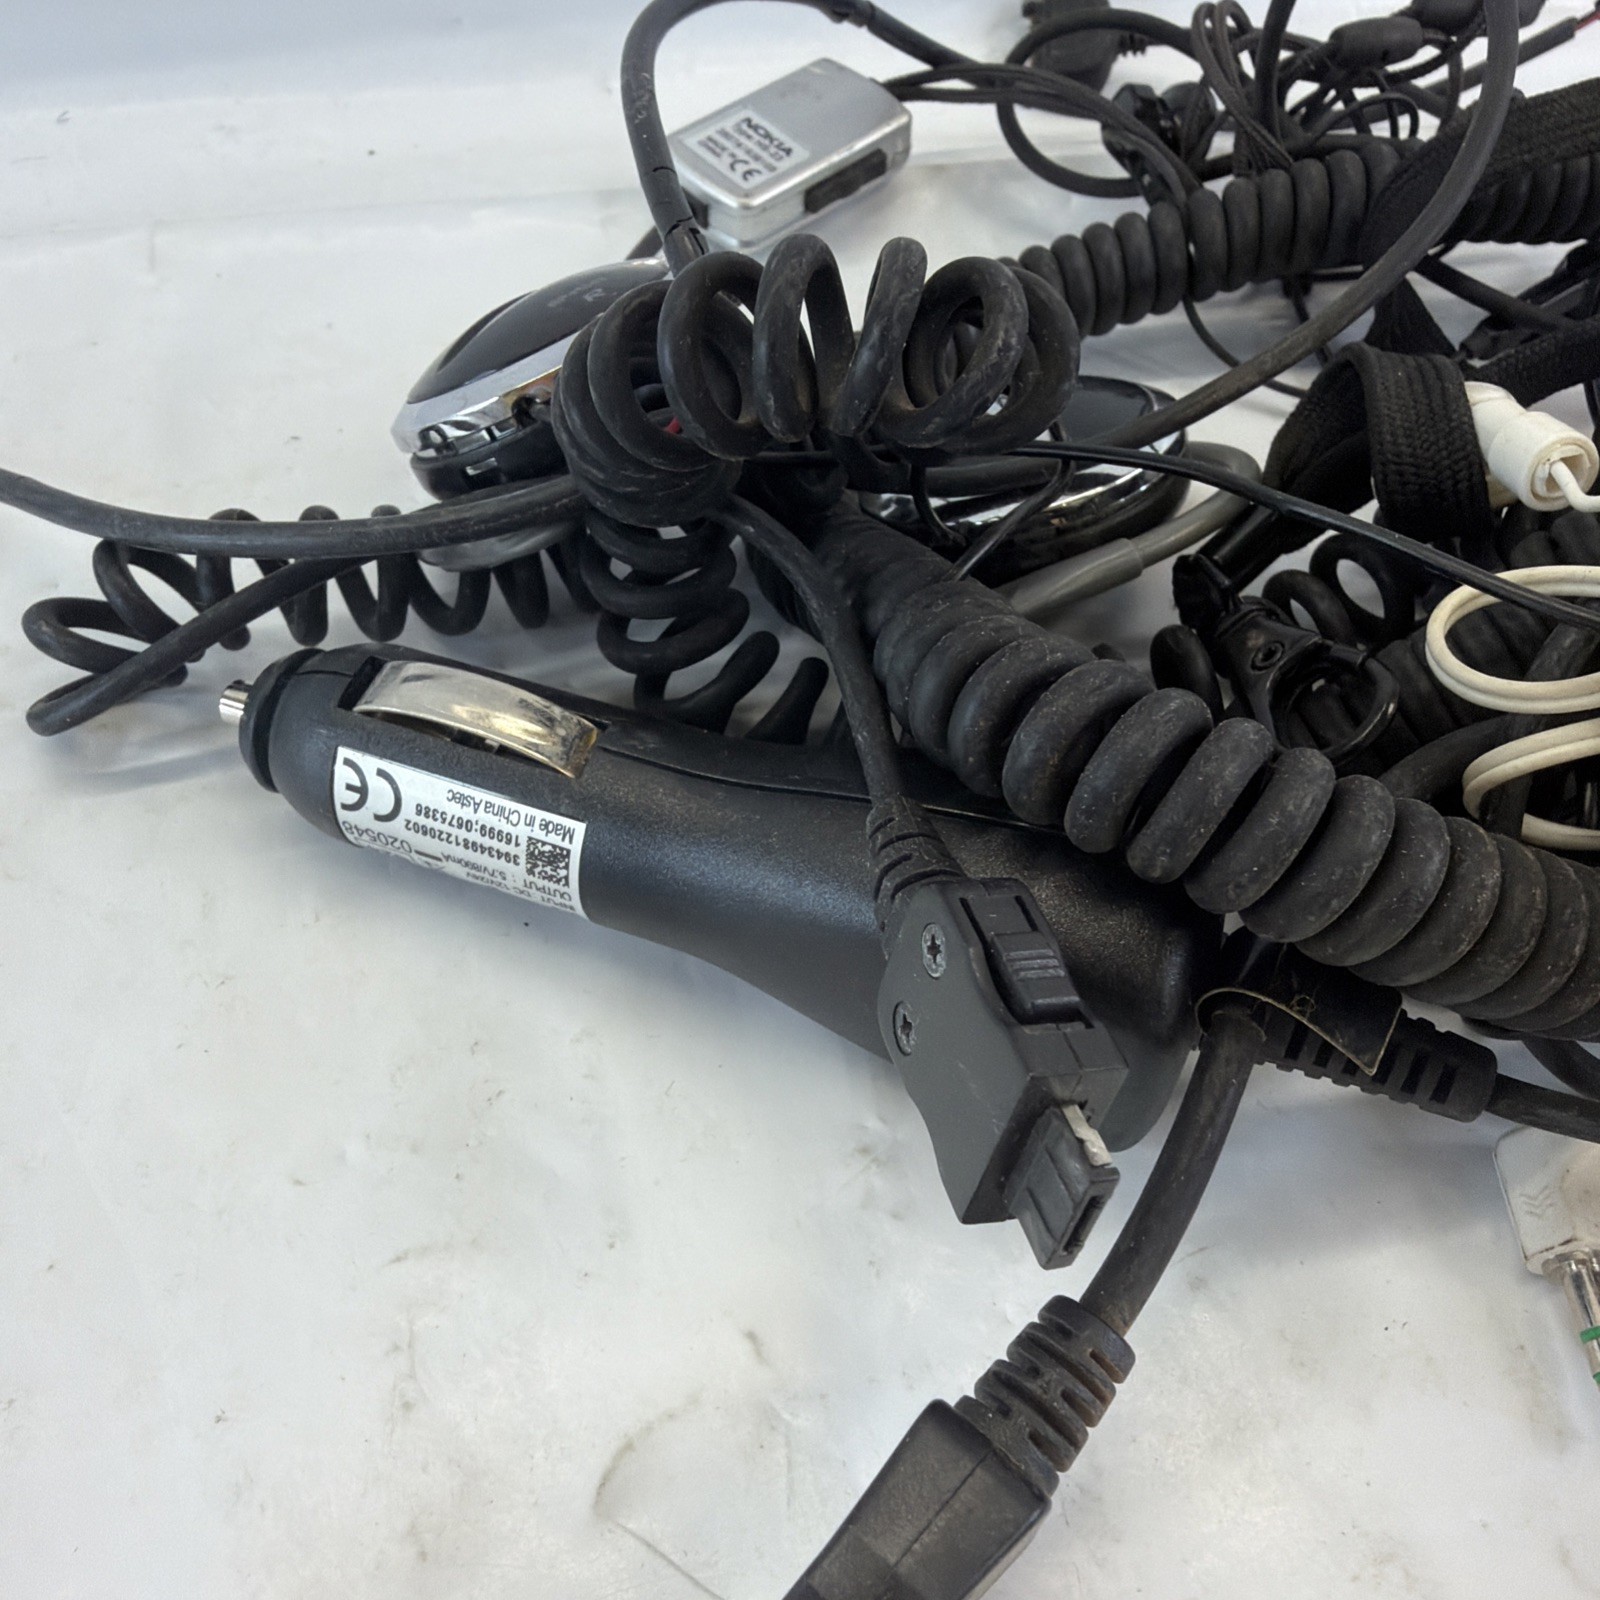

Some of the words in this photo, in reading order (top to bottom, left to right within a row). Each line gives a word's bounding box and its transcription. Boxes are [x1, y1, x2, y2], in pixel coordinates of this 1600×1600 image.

[741, 117, 793, 157] NOKIA
[340, 757, 402, 822] CE
[446, 789, 482, 814] Astec
[484, 801, 521, 826] China
[523, 817, 537, 833] in
[539, 823, 576, 844] Made
[523, 878, 571, 902] OUTPUT
